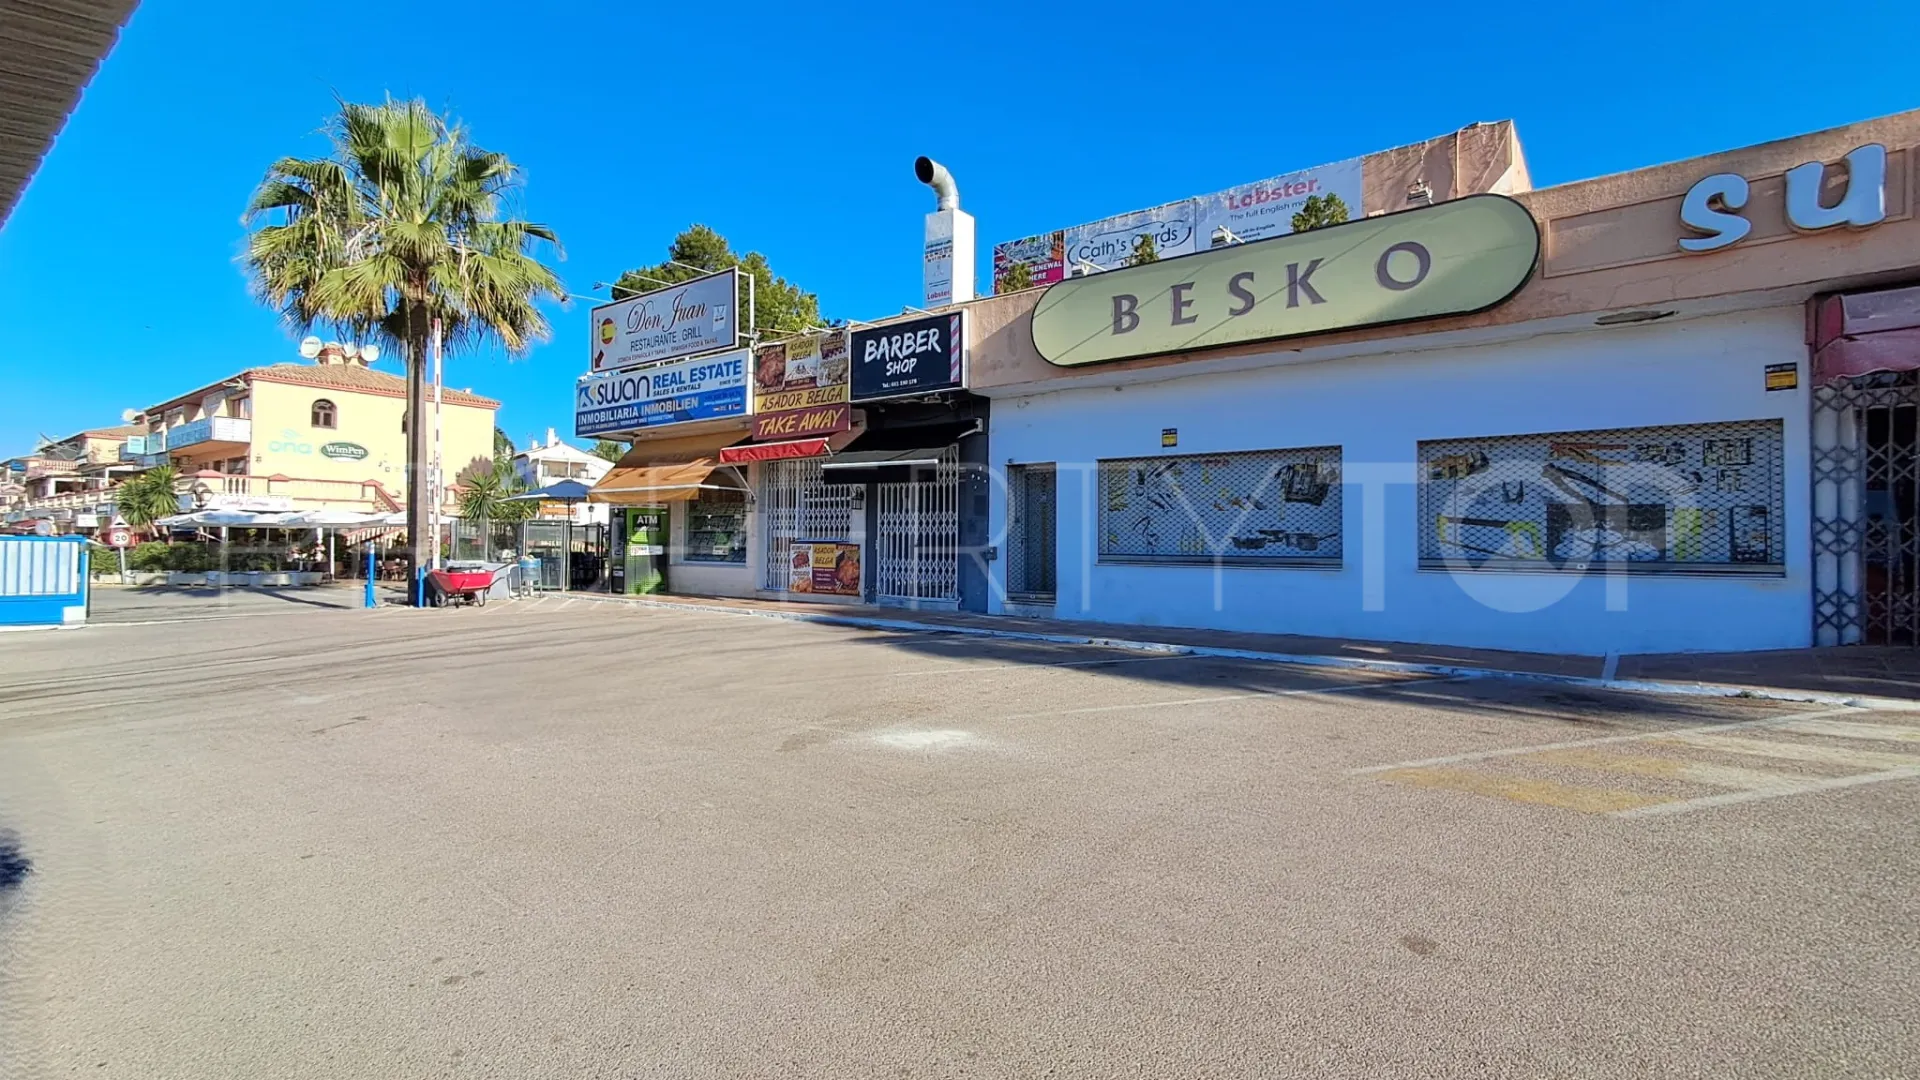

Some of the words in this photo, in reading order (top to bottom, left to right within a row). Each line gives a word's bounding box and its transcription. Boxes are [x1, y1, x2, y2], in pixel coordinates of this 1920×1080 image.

[1230, 213, 1244, 222] The
[1246, 209, 1259, 218] full
[1260, 203, 1290, 216] English
[1079, 239, 1127, 260] Cath's
[1131, 228, 1178, 252] Crds
[1111, 240, 1431, 336] BESKO
[625, 300, 662, 335] Don
[662, 288, 708, 332] Juan
[630, 331, 677, 352] RESTAURANTE
[682, 325, 702, 342] GRILL
[790, 340, 814, 350] ASADOR
[864, 328, 942, 364] BARBER
[791, 351, 812, 361] BELGA
[886, 358, 917, 376] SHOP
[653, 371, 686, 390] REAL
[690, 359, 743, 383] ESTATE
[653, 389, 670, 397] SALES
[676, 383, 701, 394] RENTALS
[761, 393, 803, 410] ASADOR
[806, 386, 843, 404] BELGA
[578, 406, 639, 426] INMOBILIARIA
[641, 397, 699, 416] INMOBILIEN
[759, 414, 798, 436] TAKE
[798, 407, 845, 432] AWAY
[326, 445, 364, 455] WimPen
[637, 515, 658, 524] ATM
